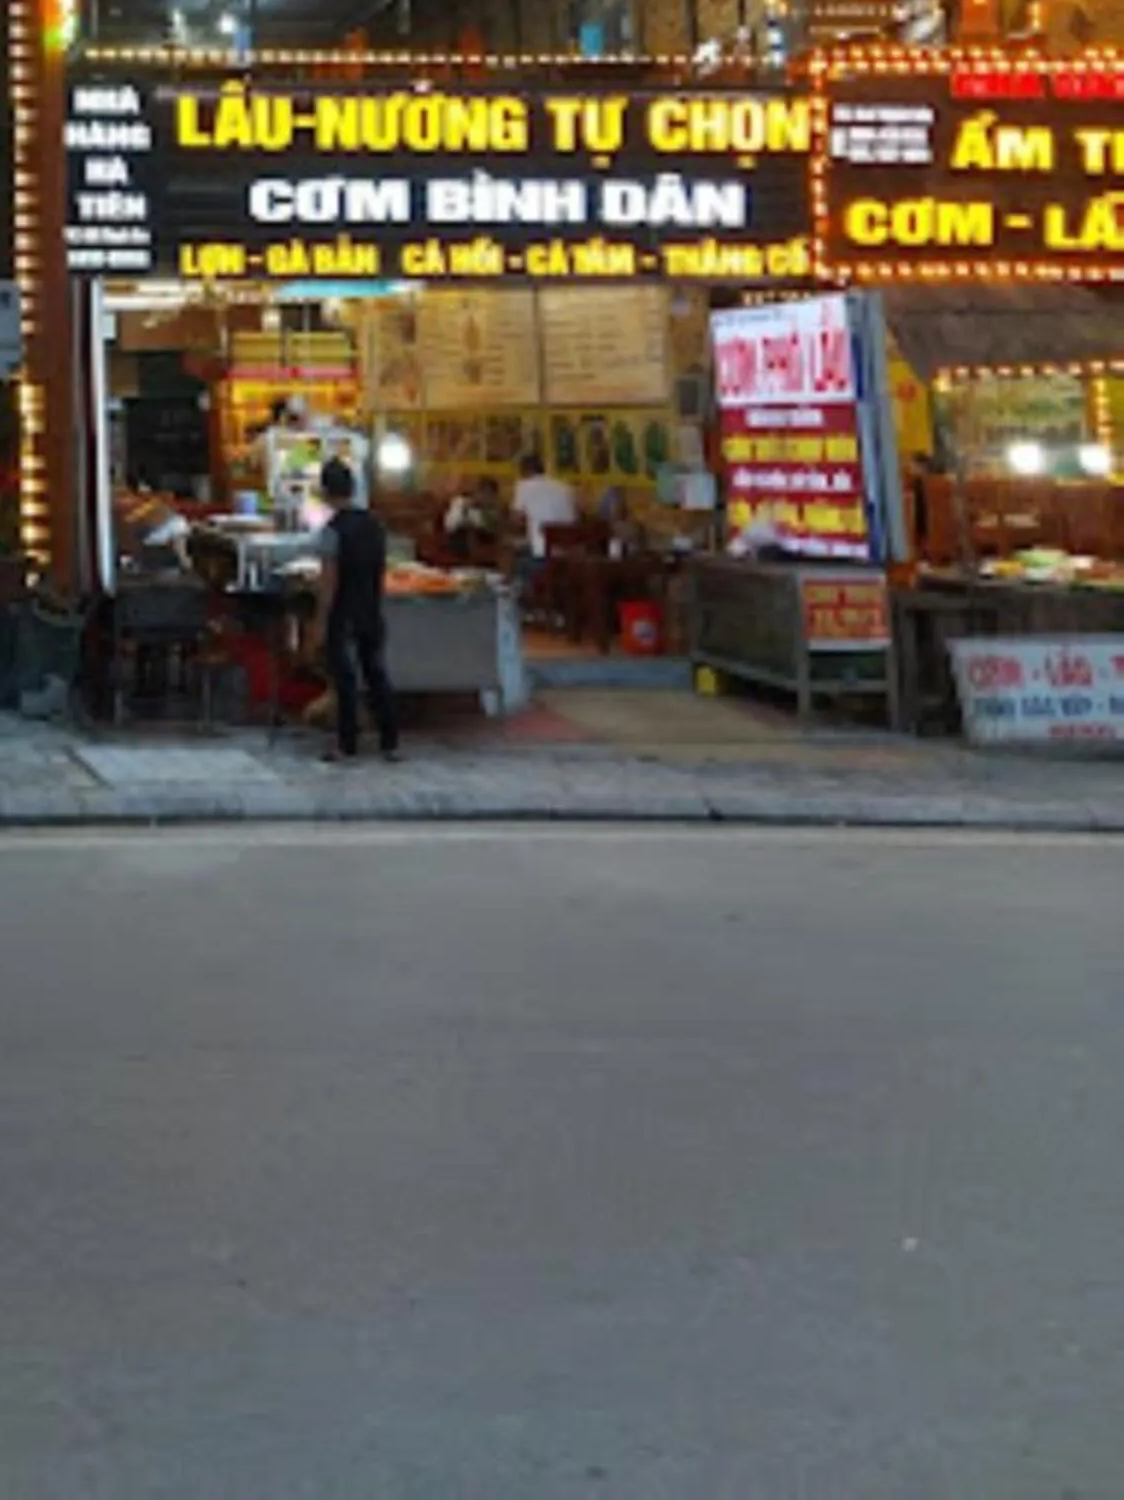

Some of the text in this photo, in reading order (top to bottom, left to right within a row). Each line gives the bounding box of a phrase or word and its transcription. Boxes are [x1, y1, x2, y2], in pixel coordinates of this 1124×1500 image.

[544, 94, 629, 168] TỰ
[647, 94, 811, 169] CHỌN
[248, 167, 746, 228] CƠM BÌNH DÂN
[845, 197, 994, 245] CƠM
